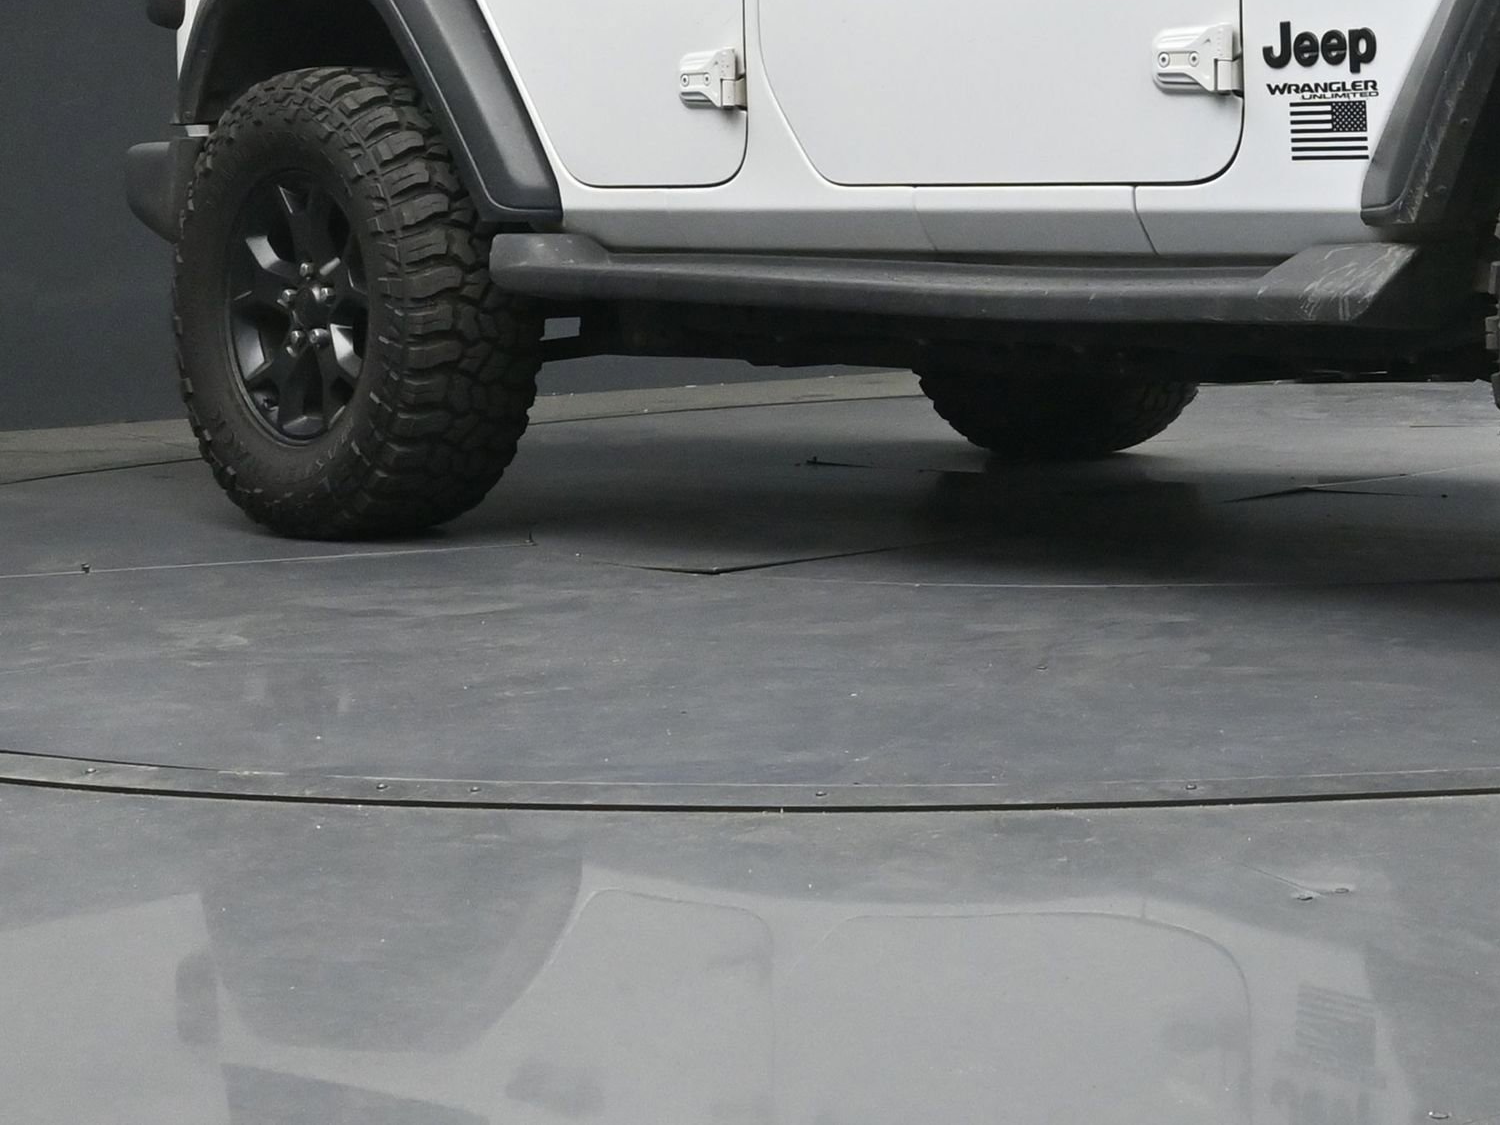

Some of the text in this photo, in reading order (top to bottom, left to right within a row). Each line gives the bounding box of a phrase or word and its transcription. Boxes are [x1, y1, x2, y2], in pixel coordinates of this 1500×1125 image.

[1262, 20, 1377, 74] Jeep
[1266, 80, 1378, 95] WRANGLER
[1301, 91, 1379, 100] UNLIMITED
